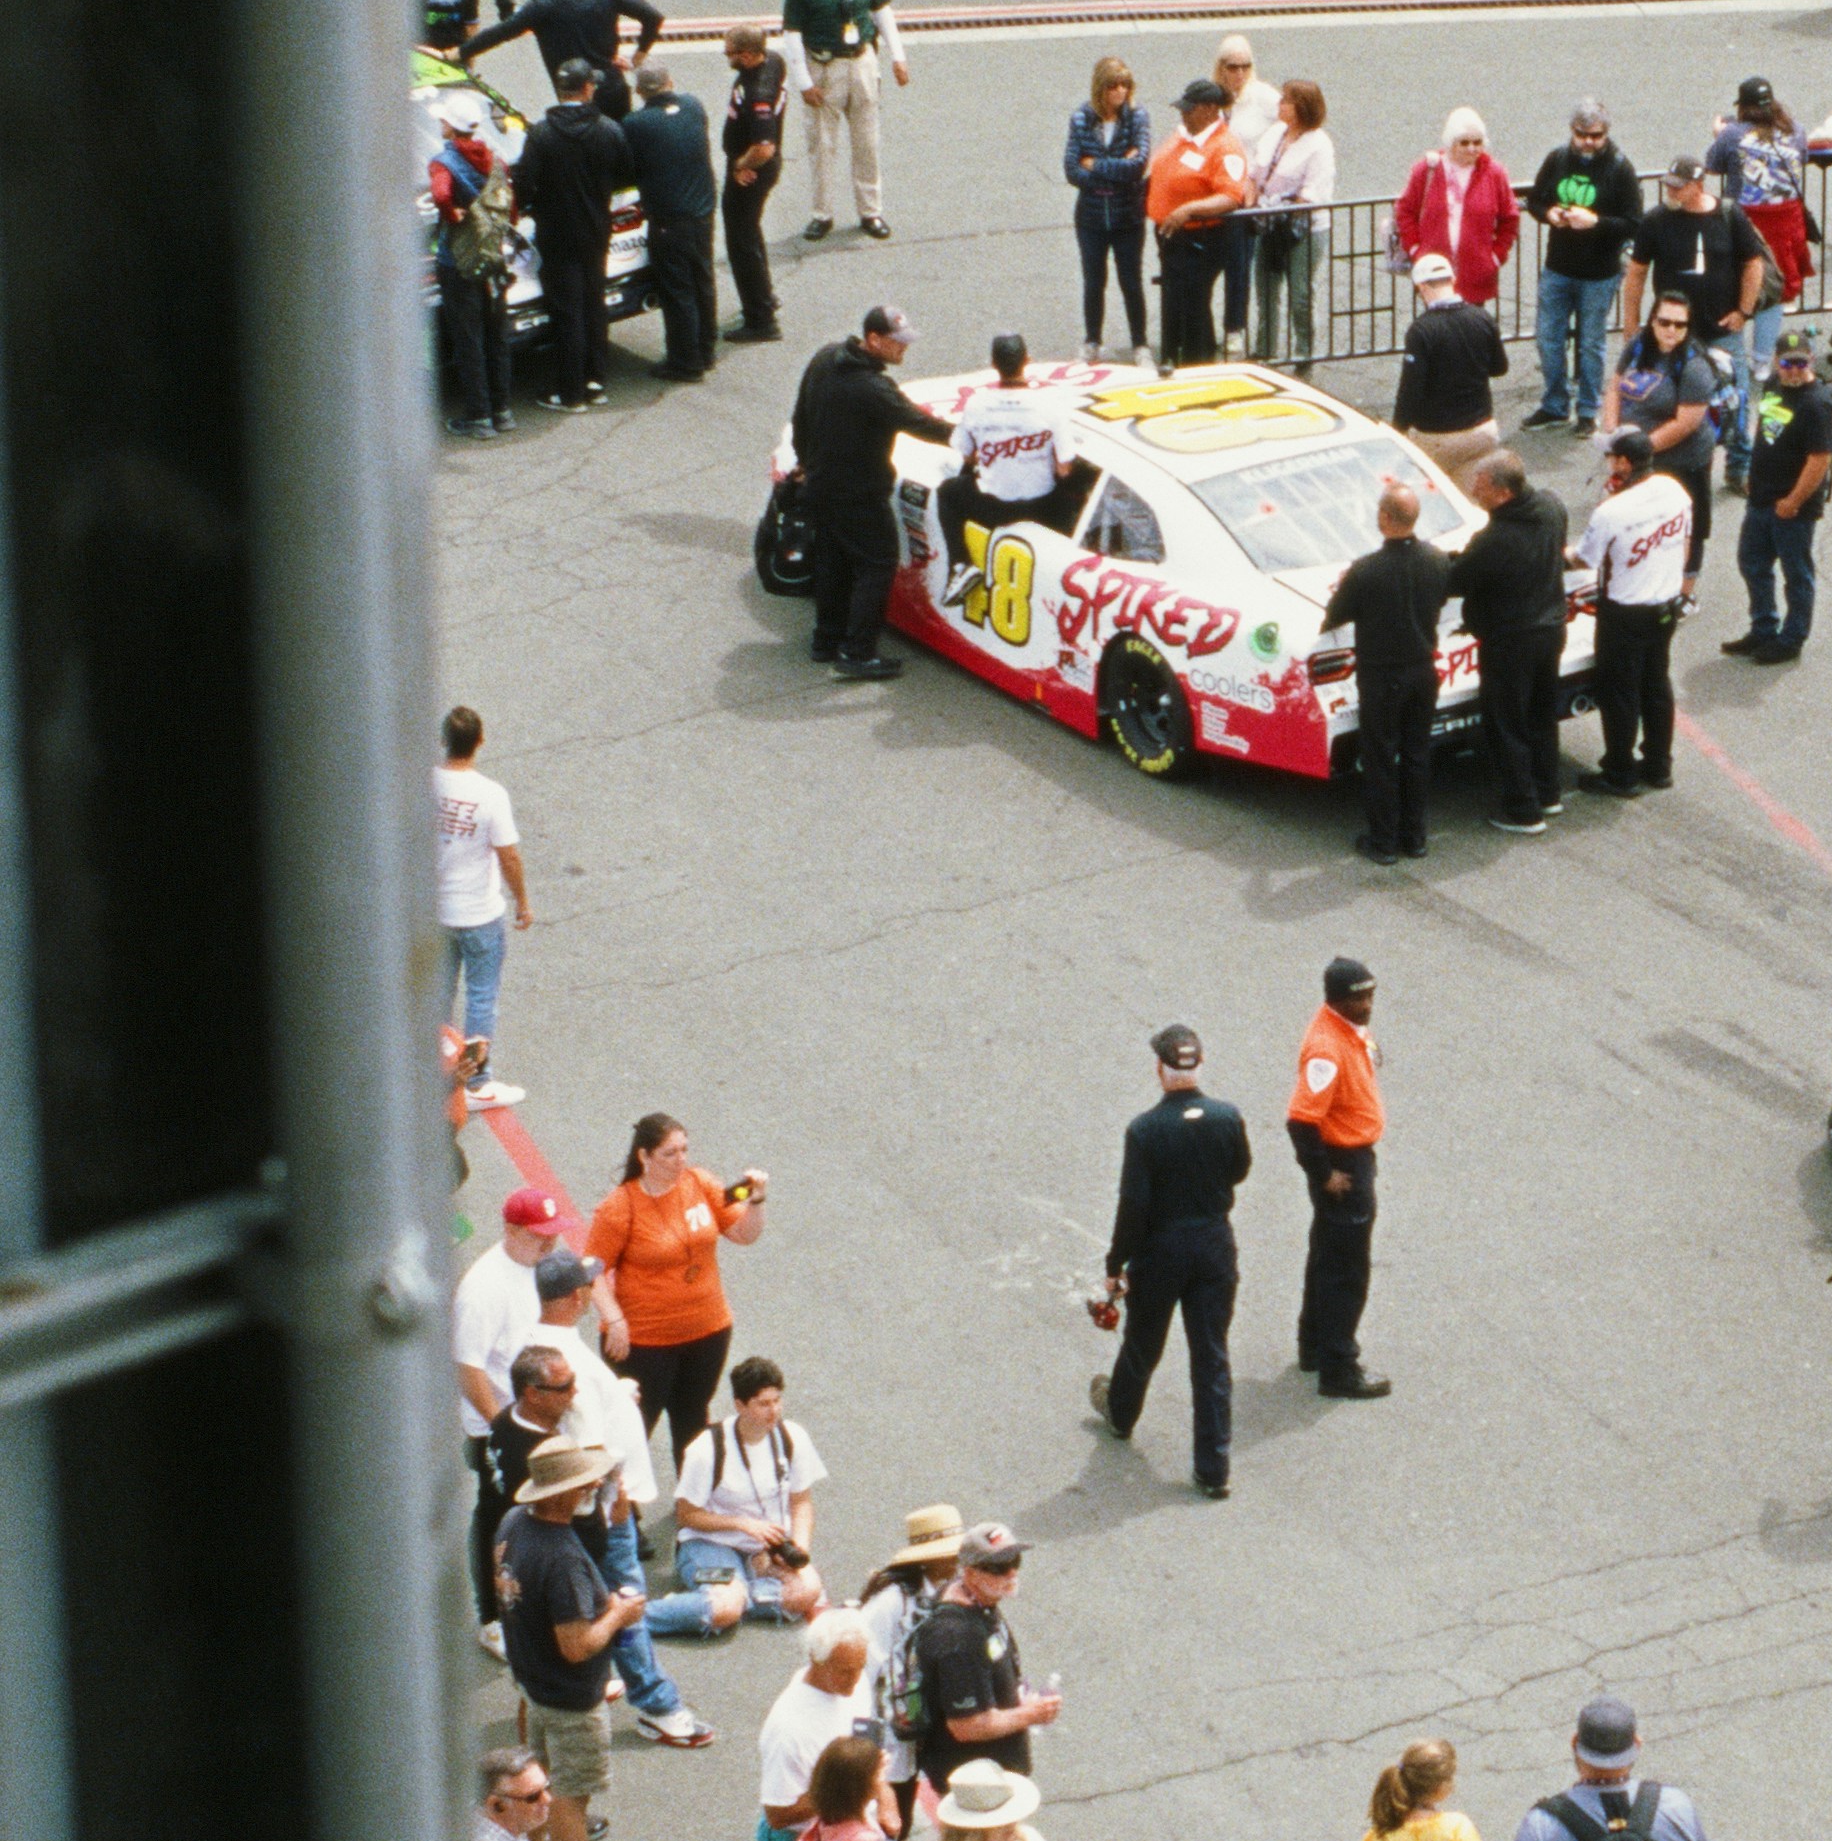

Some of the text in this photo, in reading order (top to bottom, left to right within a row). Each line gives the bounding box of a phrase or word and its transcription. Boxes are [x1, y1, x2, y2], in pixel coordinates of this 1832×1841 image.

[960, 519, 1036, 647] 48
[1056, 556, 1241, 658] SPIKED
[1188, 668, 1274, 712] coolers
